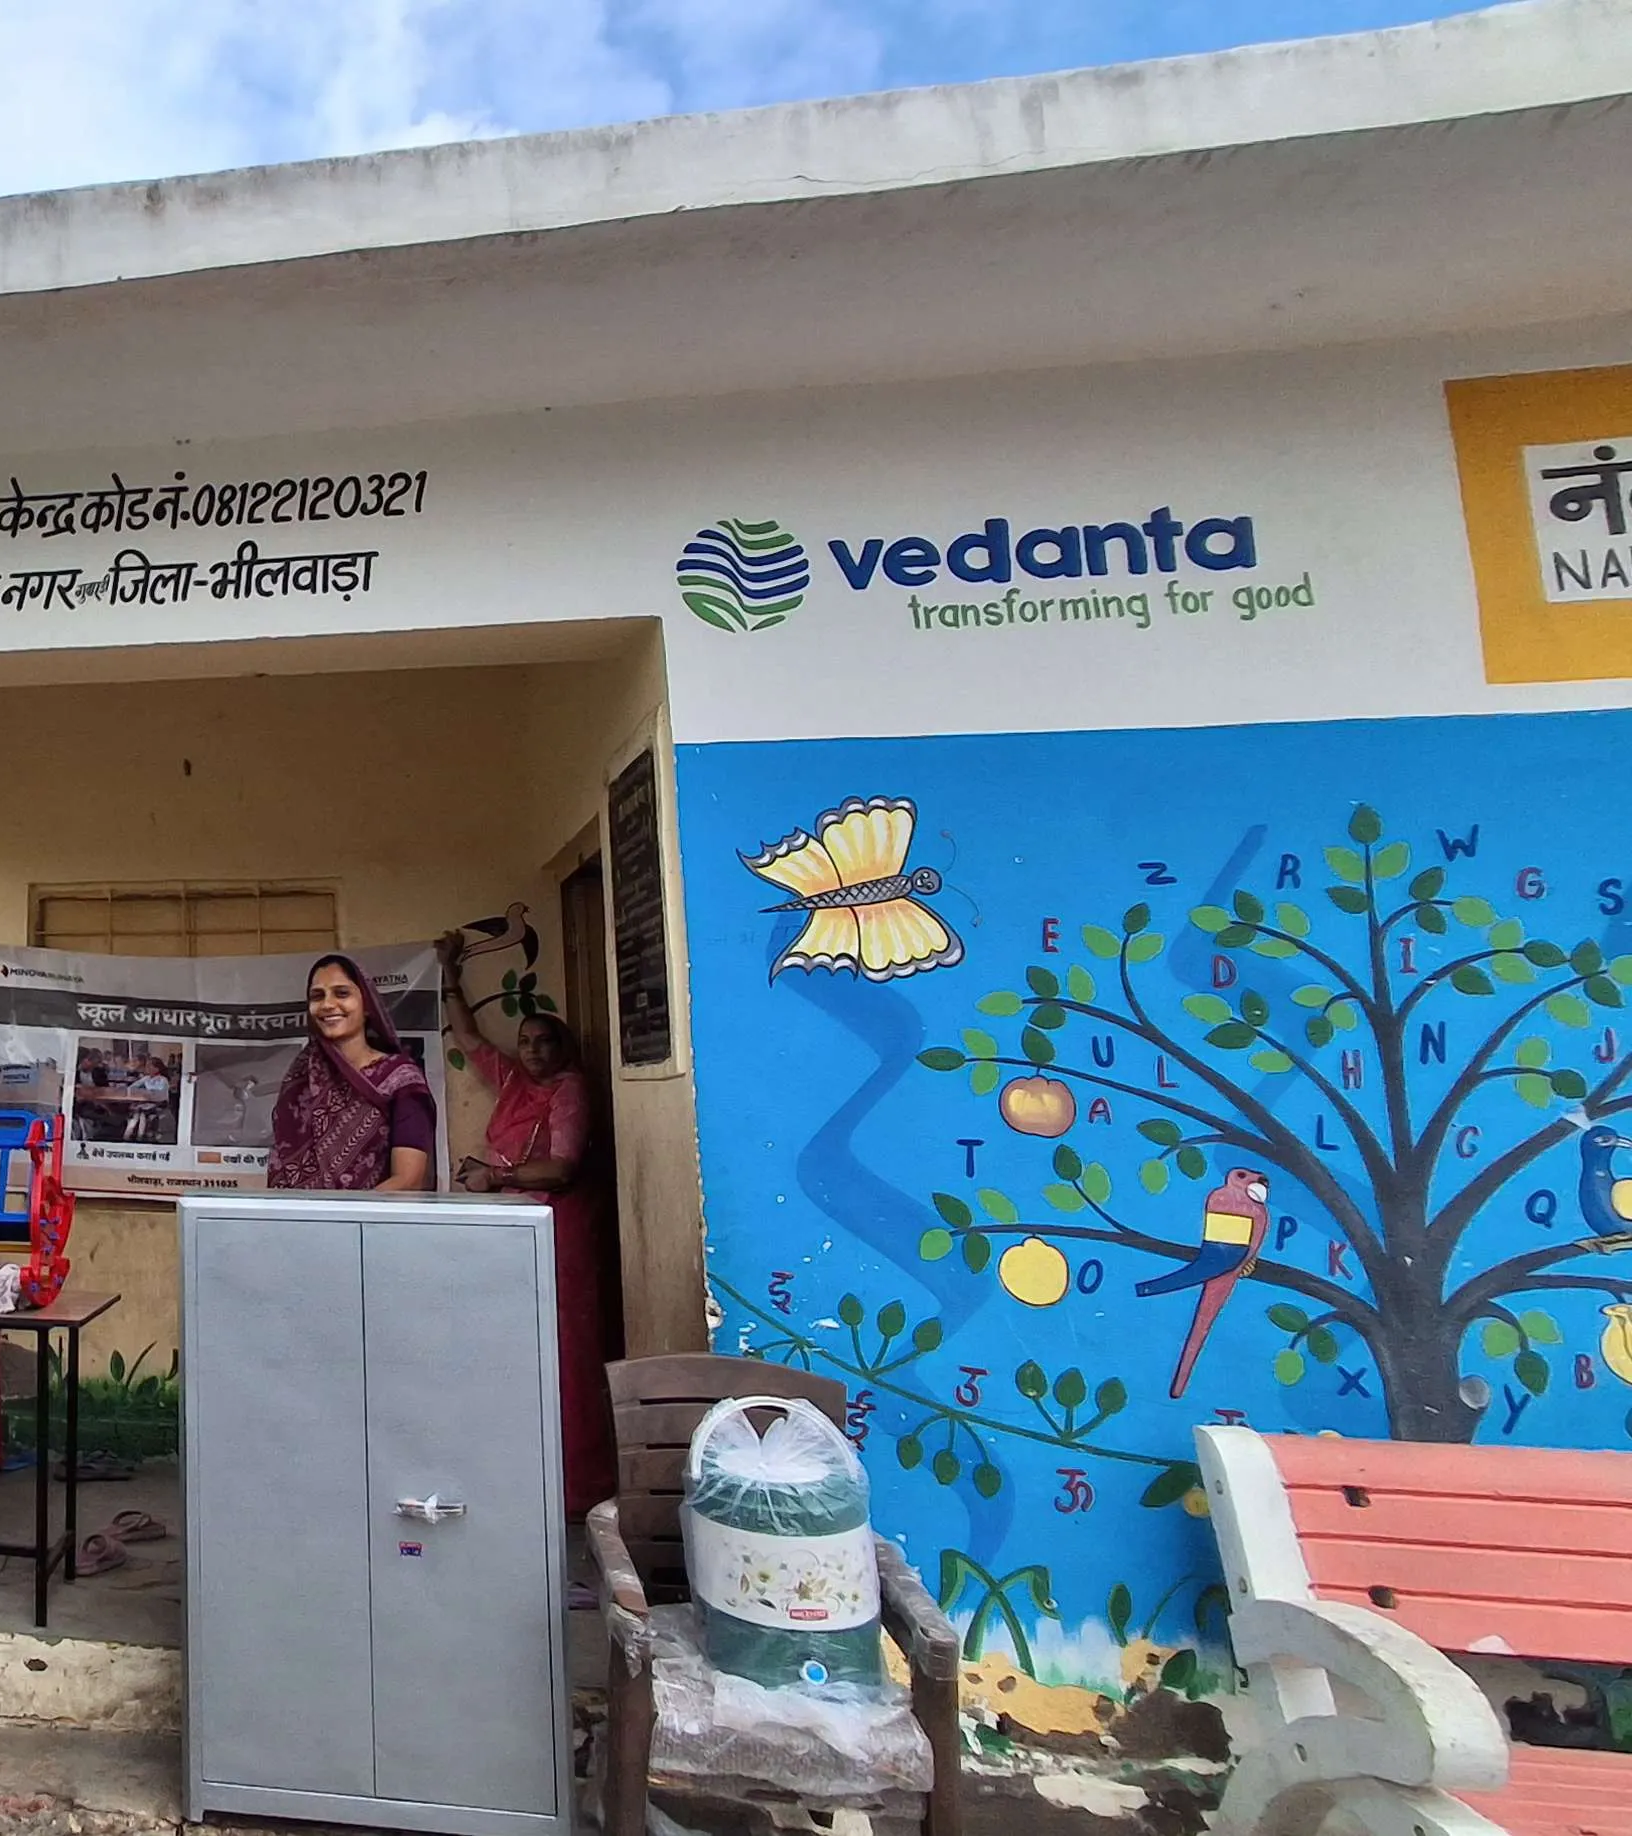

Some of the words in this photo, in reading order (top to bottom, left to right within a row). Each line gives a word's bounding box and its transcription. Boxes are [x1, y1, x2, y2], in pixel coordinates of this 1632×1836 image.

[1541, 445, 1632, 535] नं
[827, 506, 1257, 590] vedanta
[1553, 545, 1632, 592] NA
[909, 588, 1150, 630] transforming
[1166, 580, 1215, 615] for
[1232, 572, 1314, 621] good
[76, 1003, 128, 1028] स्कूल
[133, 1006, 232, 1035] आधारभूत
